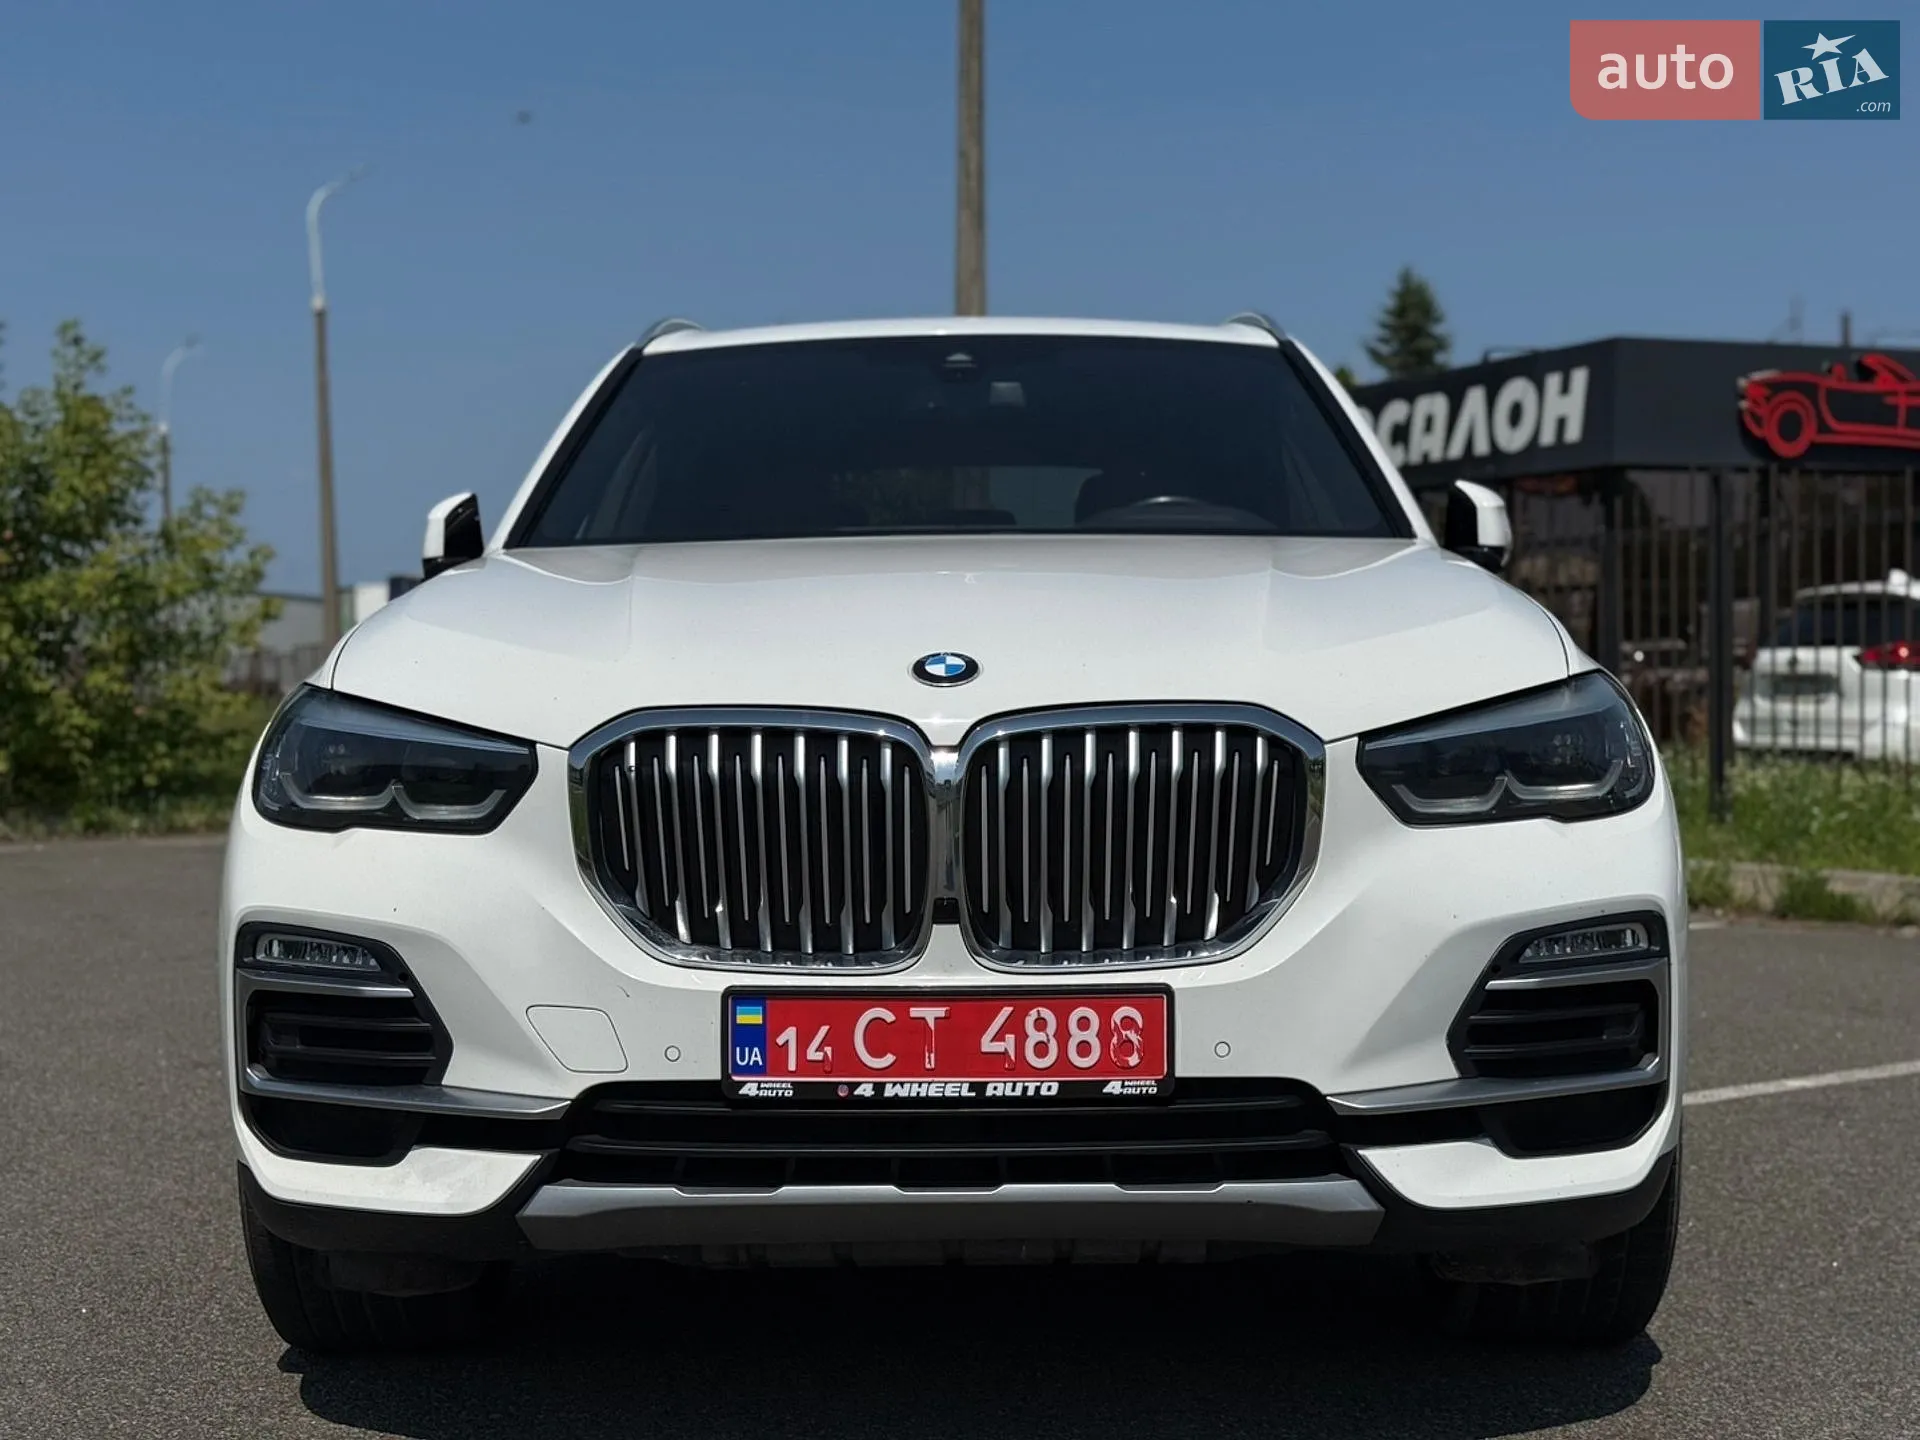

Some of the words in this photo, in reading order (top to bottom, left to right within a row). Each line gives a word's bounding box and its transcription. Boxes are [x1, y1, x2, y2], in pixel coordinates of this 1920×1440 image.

[775, 1025, 833, 1073] 14
[852, 1006, 950, 1069] CT
[980, 1005, 1144, 1069] 4888
[735, 1046, 763, 1067] UA
[738, 1082, 759, 1097] 4
[852, 1082, 875, 1098] 4
[883, 1082, 977, 1098] WHEEL
[985, 1081, 1060, 1097] AUTO
[1102, 1080, 1123, 1095] 4
